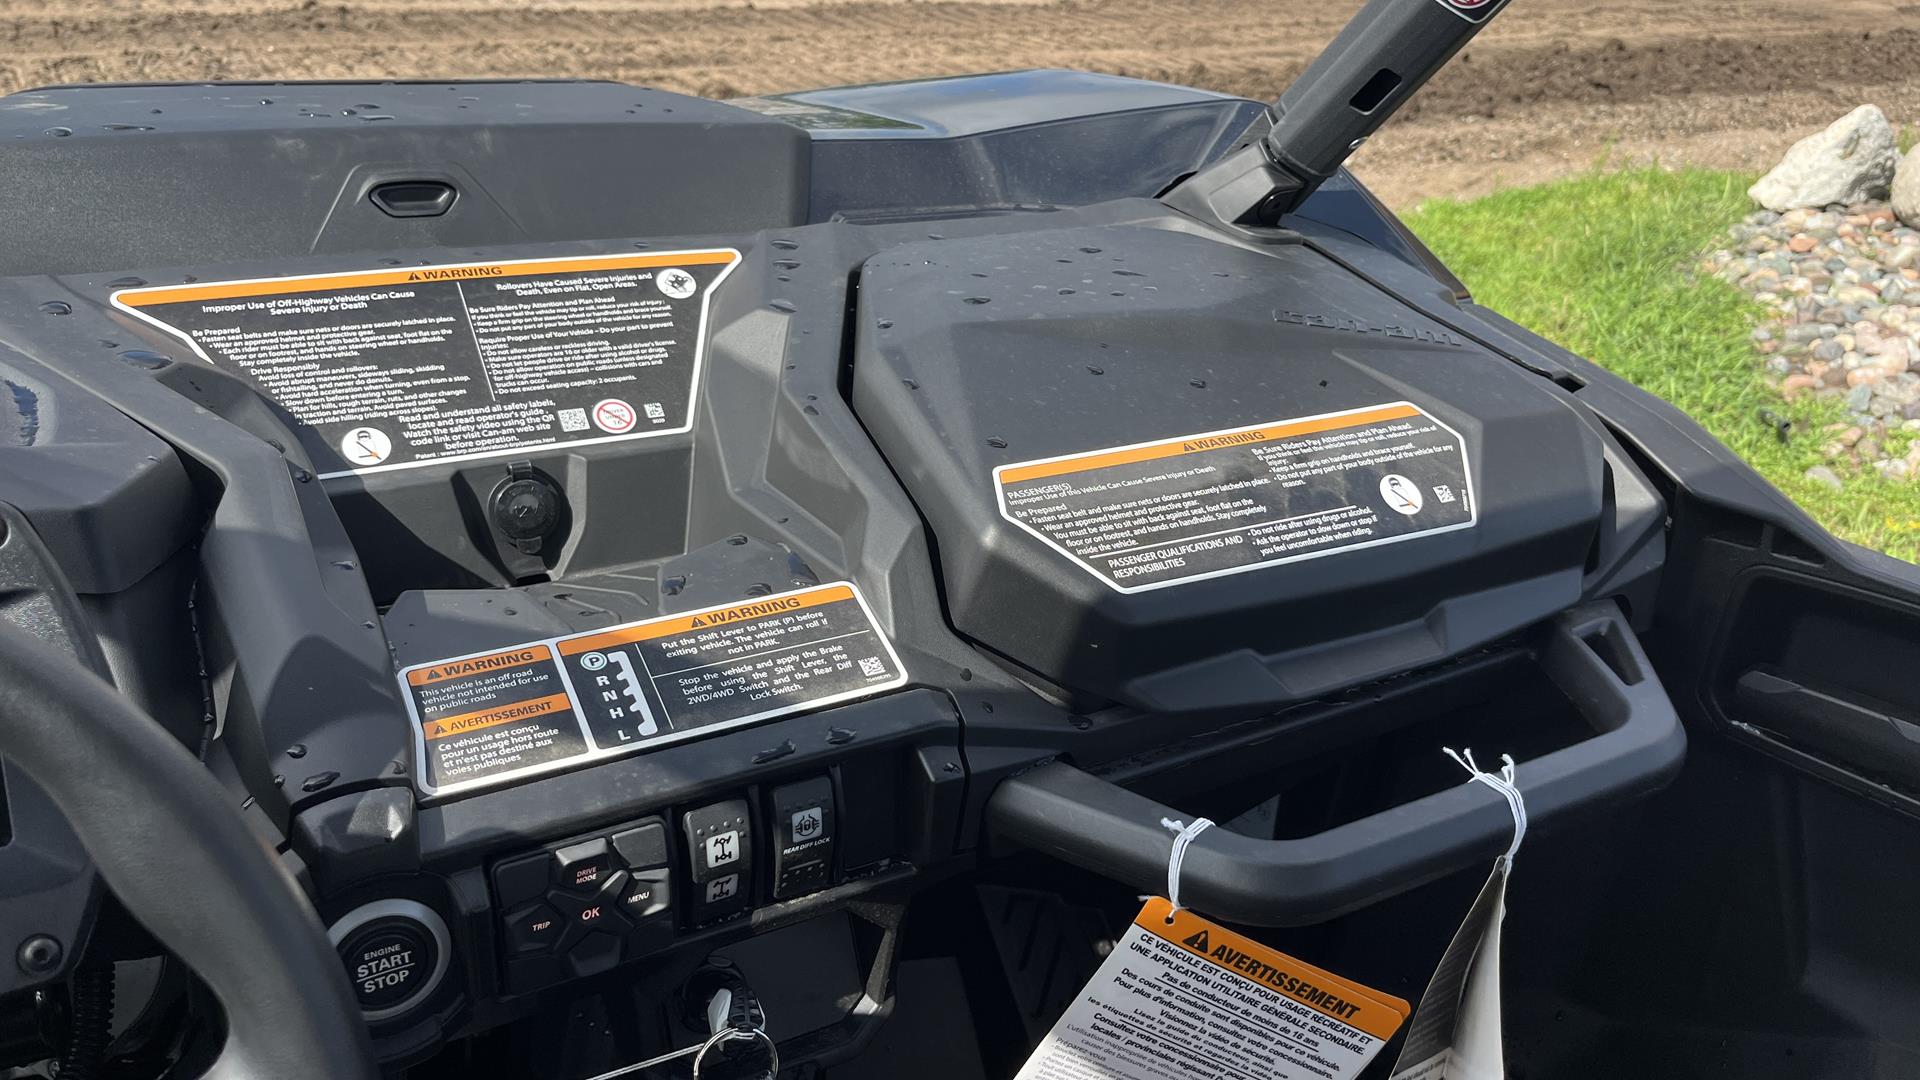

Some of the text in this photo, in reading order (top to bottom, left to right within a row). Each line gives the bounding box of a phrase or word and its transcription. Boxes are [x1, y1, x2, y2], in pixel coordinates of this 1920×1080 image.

[424, 266, 502, 280] WARNING
[203, 305, 245, 314] Improper
[277, 298, 333, 307] Off-Highway
[334, 295, 369, 303] Vehicles
[302, 306, 328, 314] Injury
[340, 302, 367, 310] Death
[204, 327, 240, 336] Prepared
[273, 363, 320, 373] Responsibly
[399, 414, 421, 423] Read
[422, 412, 440, 420] and
[441, 406, 490, 418] understand
[503, 402, 528, 411] safety
[528, 399, 556, 408] labels,
[1194, 432, 1266, 450] WARNING
[1007, 482, 1072, 498] PASSENGER(S)
[1282, 480, 1306, 489] reason.
[1028, 503, 1066, 515] Prepared
[1262, 525, 1274, 533] not
[1288, 521, 1302, 529] after
[1303, 518, 1322, 526] using
[1348, 508, 1372, 517] alcohol.
[1109, 535, 1243, 567] PASSENGER QUALIFICATIONS AND
[1113, 557, 1186, 579] RESPONSIBILITIES
[707, 597, 800, 625] WARNING
[661, 640, 678, 649] Put
[679, 638, 695, 646] the
[697, 632, 719, 642] Shift
[720, 628, 744, 637] Lever
[758, 619, 781, 630] PARK
[782, 616, 795, 626] (P)
[796, 612, 823, 622] before
[667, 647, 698, 657] exiting
[700, 640, 734, 651] vehicle.
[736, 635, 752, 643] The
[754, 629, 785, 640] vehicle
[787, 625, 803, 633] can
[805, 620, 820, 629] roll
[728, 645, 744, 654] not
[754, 638, 780, 649] PARK.
[444, 651, 534, 676] WARNING
[590, 657, 600, 666] P
[679, 646, 842, 686] Stop the vehicle and apply the Brake
[420, 689, 439, 697] This
[440, 682, 473, 693] vehicle
[497, 673, 510, 682] off
[512, 669, 533, 678] road
[596, 676, 610, 685] R
[683, 654, 847, 695] before using the Shift Lever, the
[687, 662, 852, 704] 2WD/4WD Switch and the Rear Diff
[423, 694, 455, 705] vehicle
[457, 689, 473, 698] not
[475, 680, 516, 694] intended
[602, 690, 617, 701] N
[750, 684, 803, 700] Lock Switch.
[439, 699, 468, 711] public
[470, 693, 496, 703] roads
[450, 702, 552, 732] AVERTISSEMENT
[609, 708, 625, 718] H
[453, 736, 493, 749] véhicule
[494, 731, 509, 740] est
[510, 726, 539, 736] conçu
[618, 730, 631, 741] L
[442, 750, 464, 761] pour
[481, 740, 510, 751] usage
[511, 736, 532, 744] hors
[533, 730, 558, 739] route
[444, 740, 552, 768] et n'est pas destiné aux
[446, 755, 521, 775] voies publiques
[782, 836, 830, 855] REAR DIFF LOCK
[576, 867, 597, 878] DRIVE
[576, 873, 597, 884] MODE
[628, 892, 649, 903] MENU
[582, 907, 600, 920] OK
[532, 921, 550, 932] TRIP
[364, 944, 400, 960] ENGINE
[357, 950, 412, 977] START
[364, 970, 409, 993] STOP
[1131, 943, 1149, 957] UNE
[1150, 952, 1211, 985] APPLICATION
[1211, 979, 1261, 1007] UTILITAIRE
[1260, 1002, 1308, 1029] GÉNÉRALE
[1141, 934, 1372, 1046] CE VÉHICULE EST CONÇU POUR USAGE RÉCRÉATIF ET
[1210, 944, 1361, 1019] AVERTISSEMENT
[1162, 971, 1320, 1047] Pas de conducteur de moins de 16 ans
